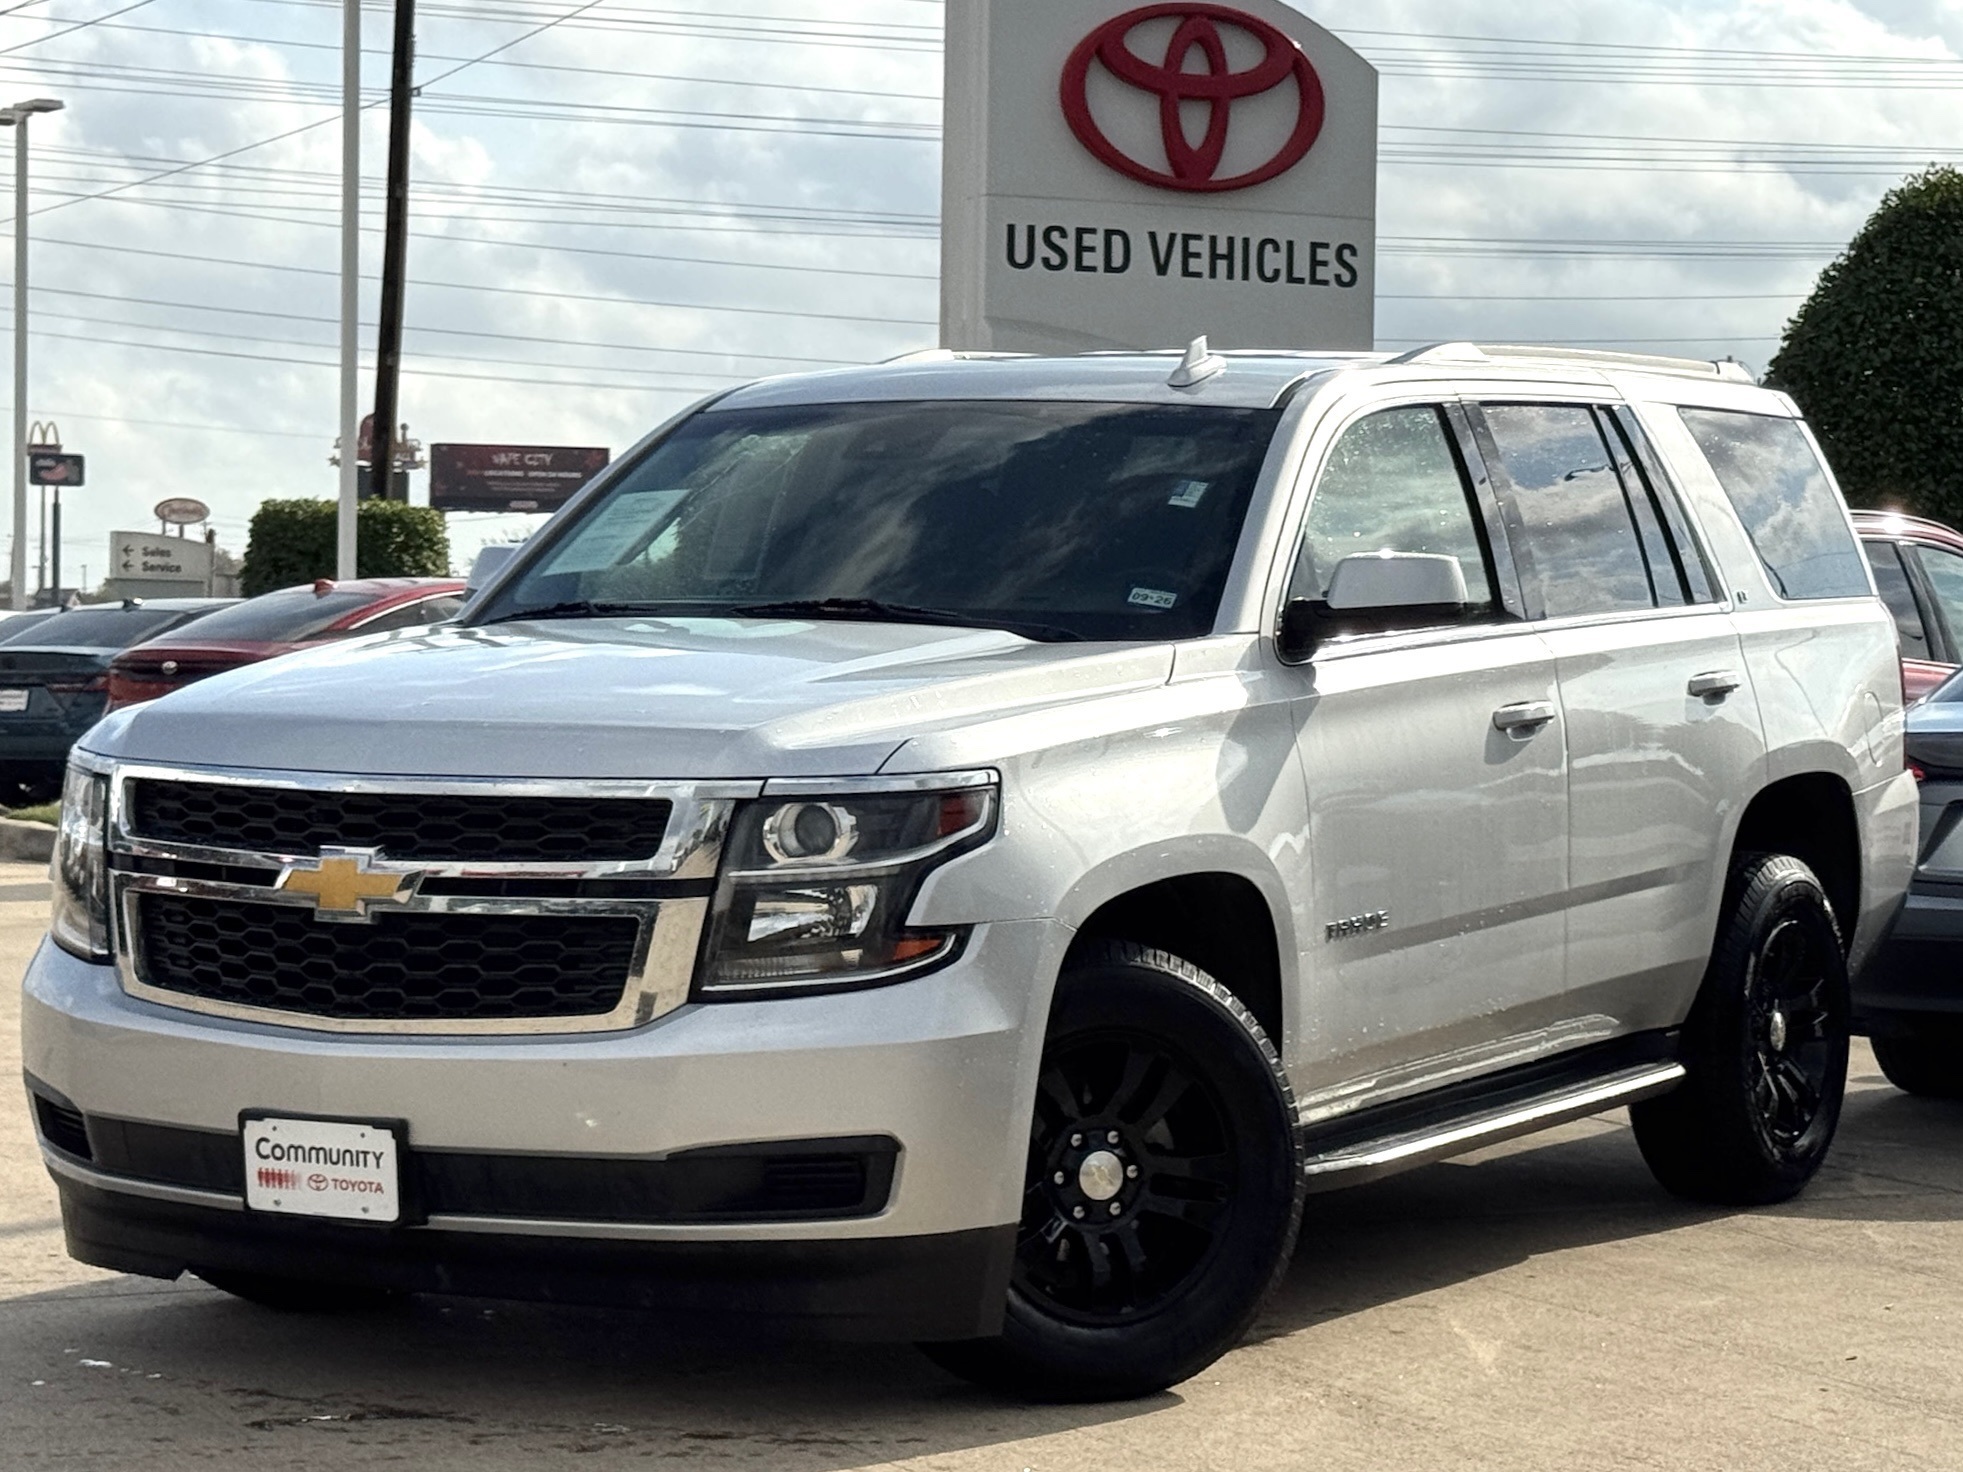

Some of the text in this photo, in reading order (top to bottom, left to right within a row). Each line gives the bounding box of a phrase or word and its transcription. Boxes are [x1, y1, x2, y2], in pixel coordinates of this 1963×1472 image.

[1006, 223, 1359, 288] USED VEHICLES
[142, 546, 172, 558] Sales
[142, 561, 183, 573] Service
[331, 1178, 384, 1194] TOYOTA
